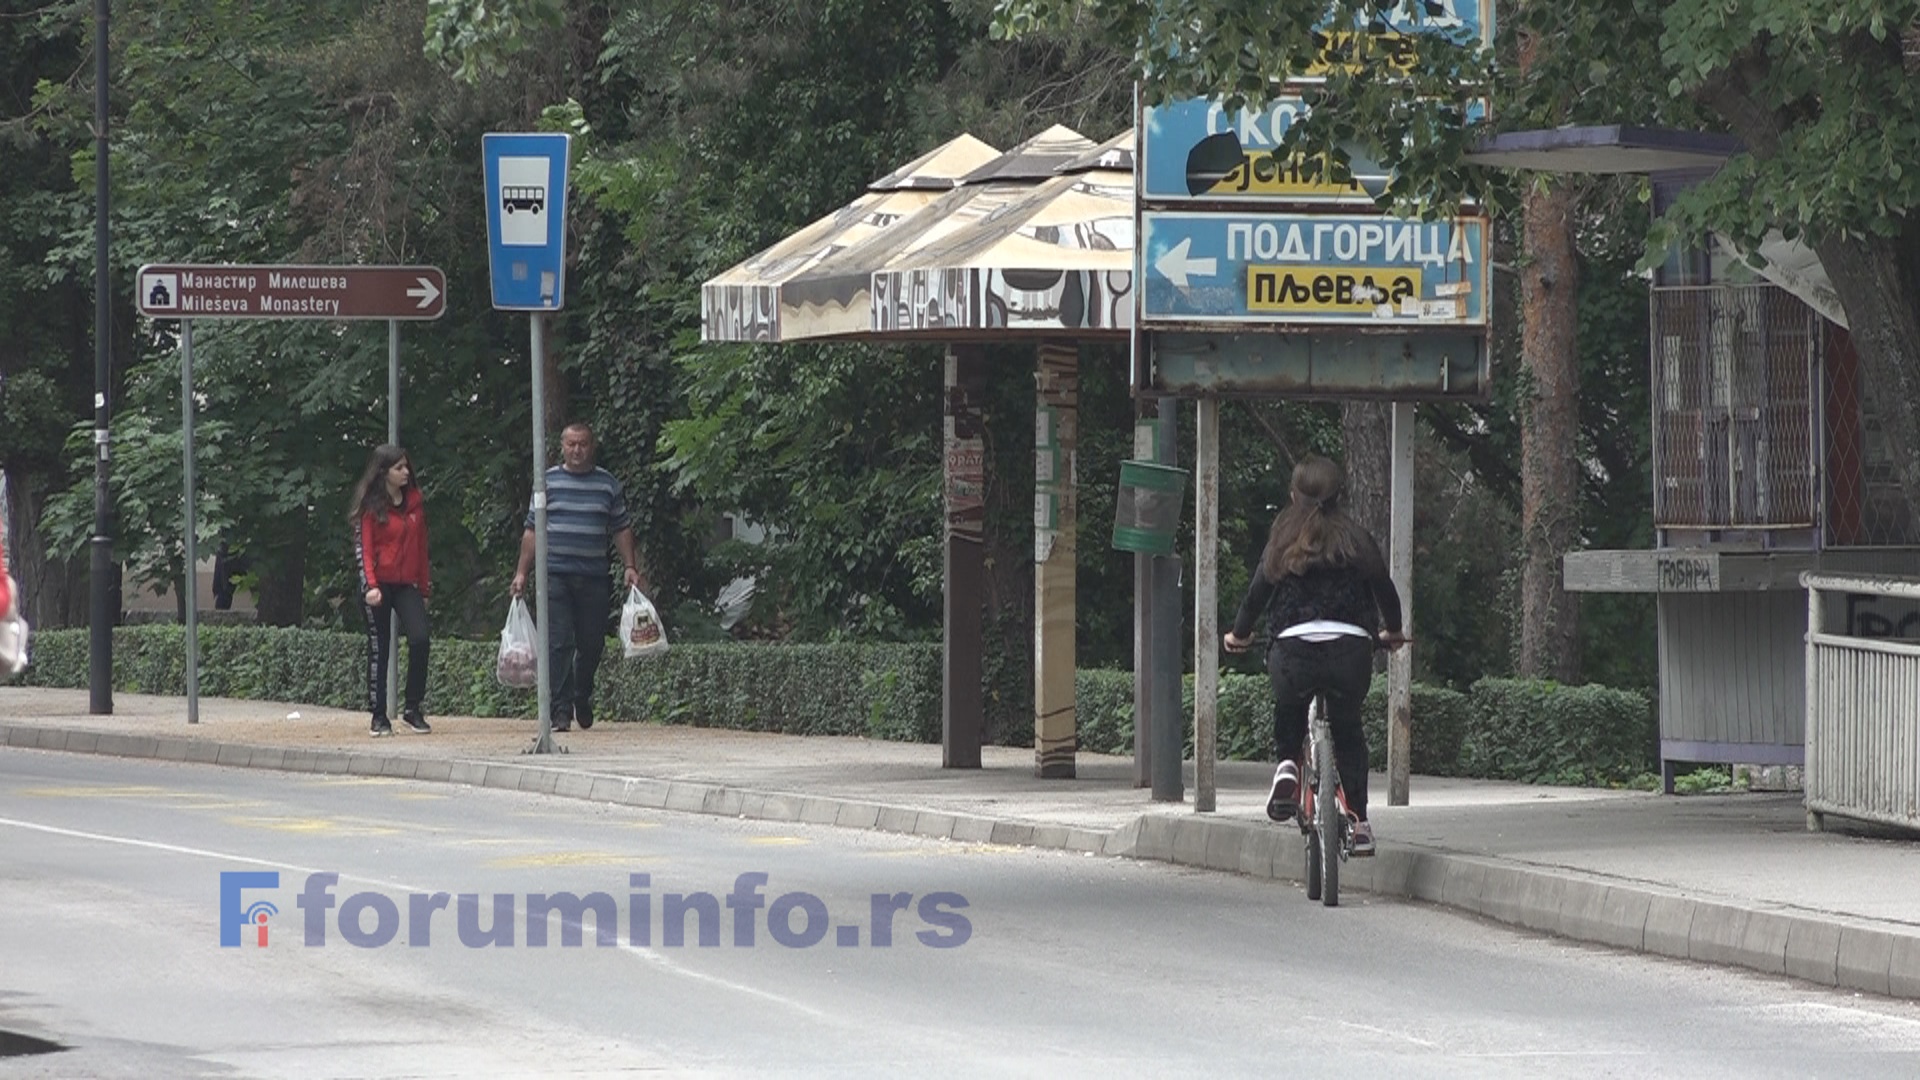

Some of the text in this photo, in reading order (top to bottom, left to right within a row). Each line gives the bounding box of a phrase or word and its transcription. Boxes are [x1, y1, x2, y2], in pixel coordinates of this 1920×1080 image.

[1227, 223, 1474, 267] ПОДГОРИЦА
[182, 272, 348, 293] Манастир Милешева
[182, 294, 341, 316] Mileševa Monastery
